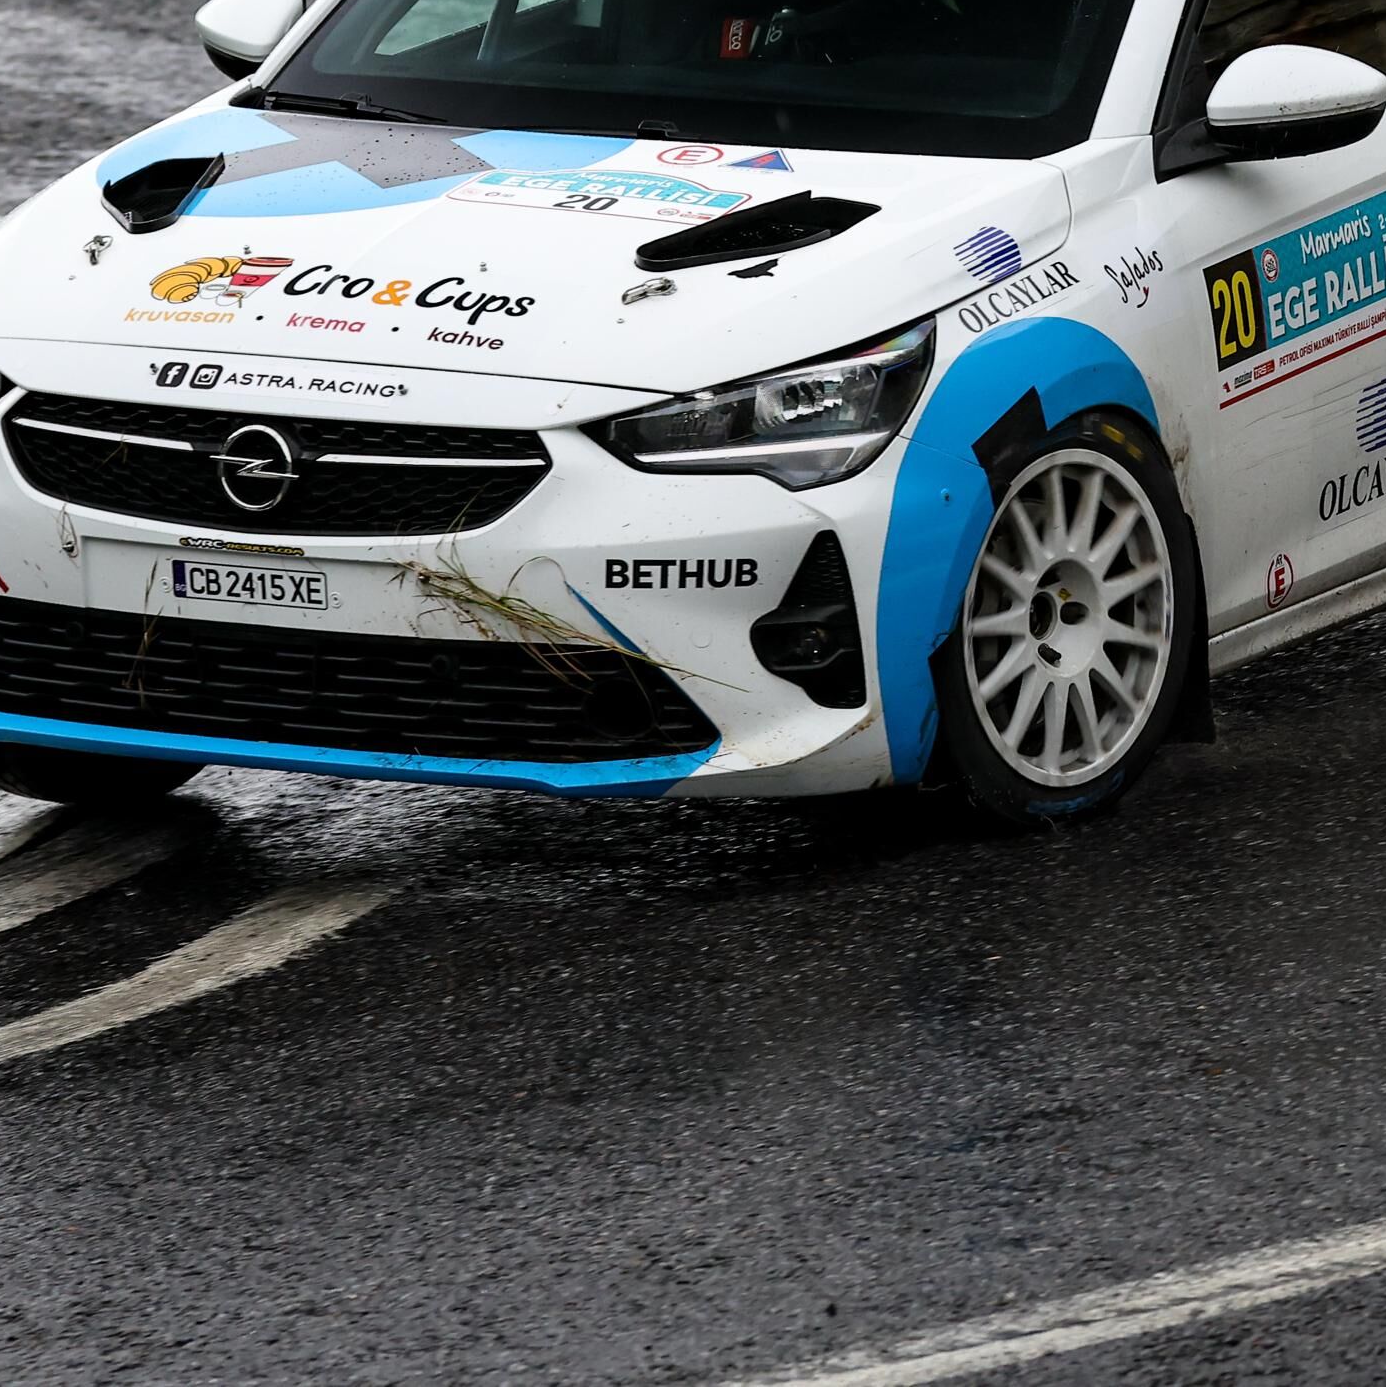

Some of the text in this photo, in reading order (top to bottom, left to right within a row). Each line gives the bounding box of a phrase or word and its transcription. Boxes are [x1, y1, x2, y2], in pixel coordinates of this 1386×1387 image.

[500, 176, 574, 190] EGE
[552, 193, 620, 212] 20
[1299, 209, 1372, 264] Marmaris
[959, 261, 1081, 334] OLCAYLAR
[1213, 270, 1256, 359] 20
[1267, 277, 1320, 340] EGE
[123, 305, 505, 351] kruvasan krema kahve
[1279, 351, 1300, 367] PETROL
[189, 568, 324, 605] CB 2415 XE
[604, 558, 759, 590] BETHUB
[1273, 567, 1286, 599] E
